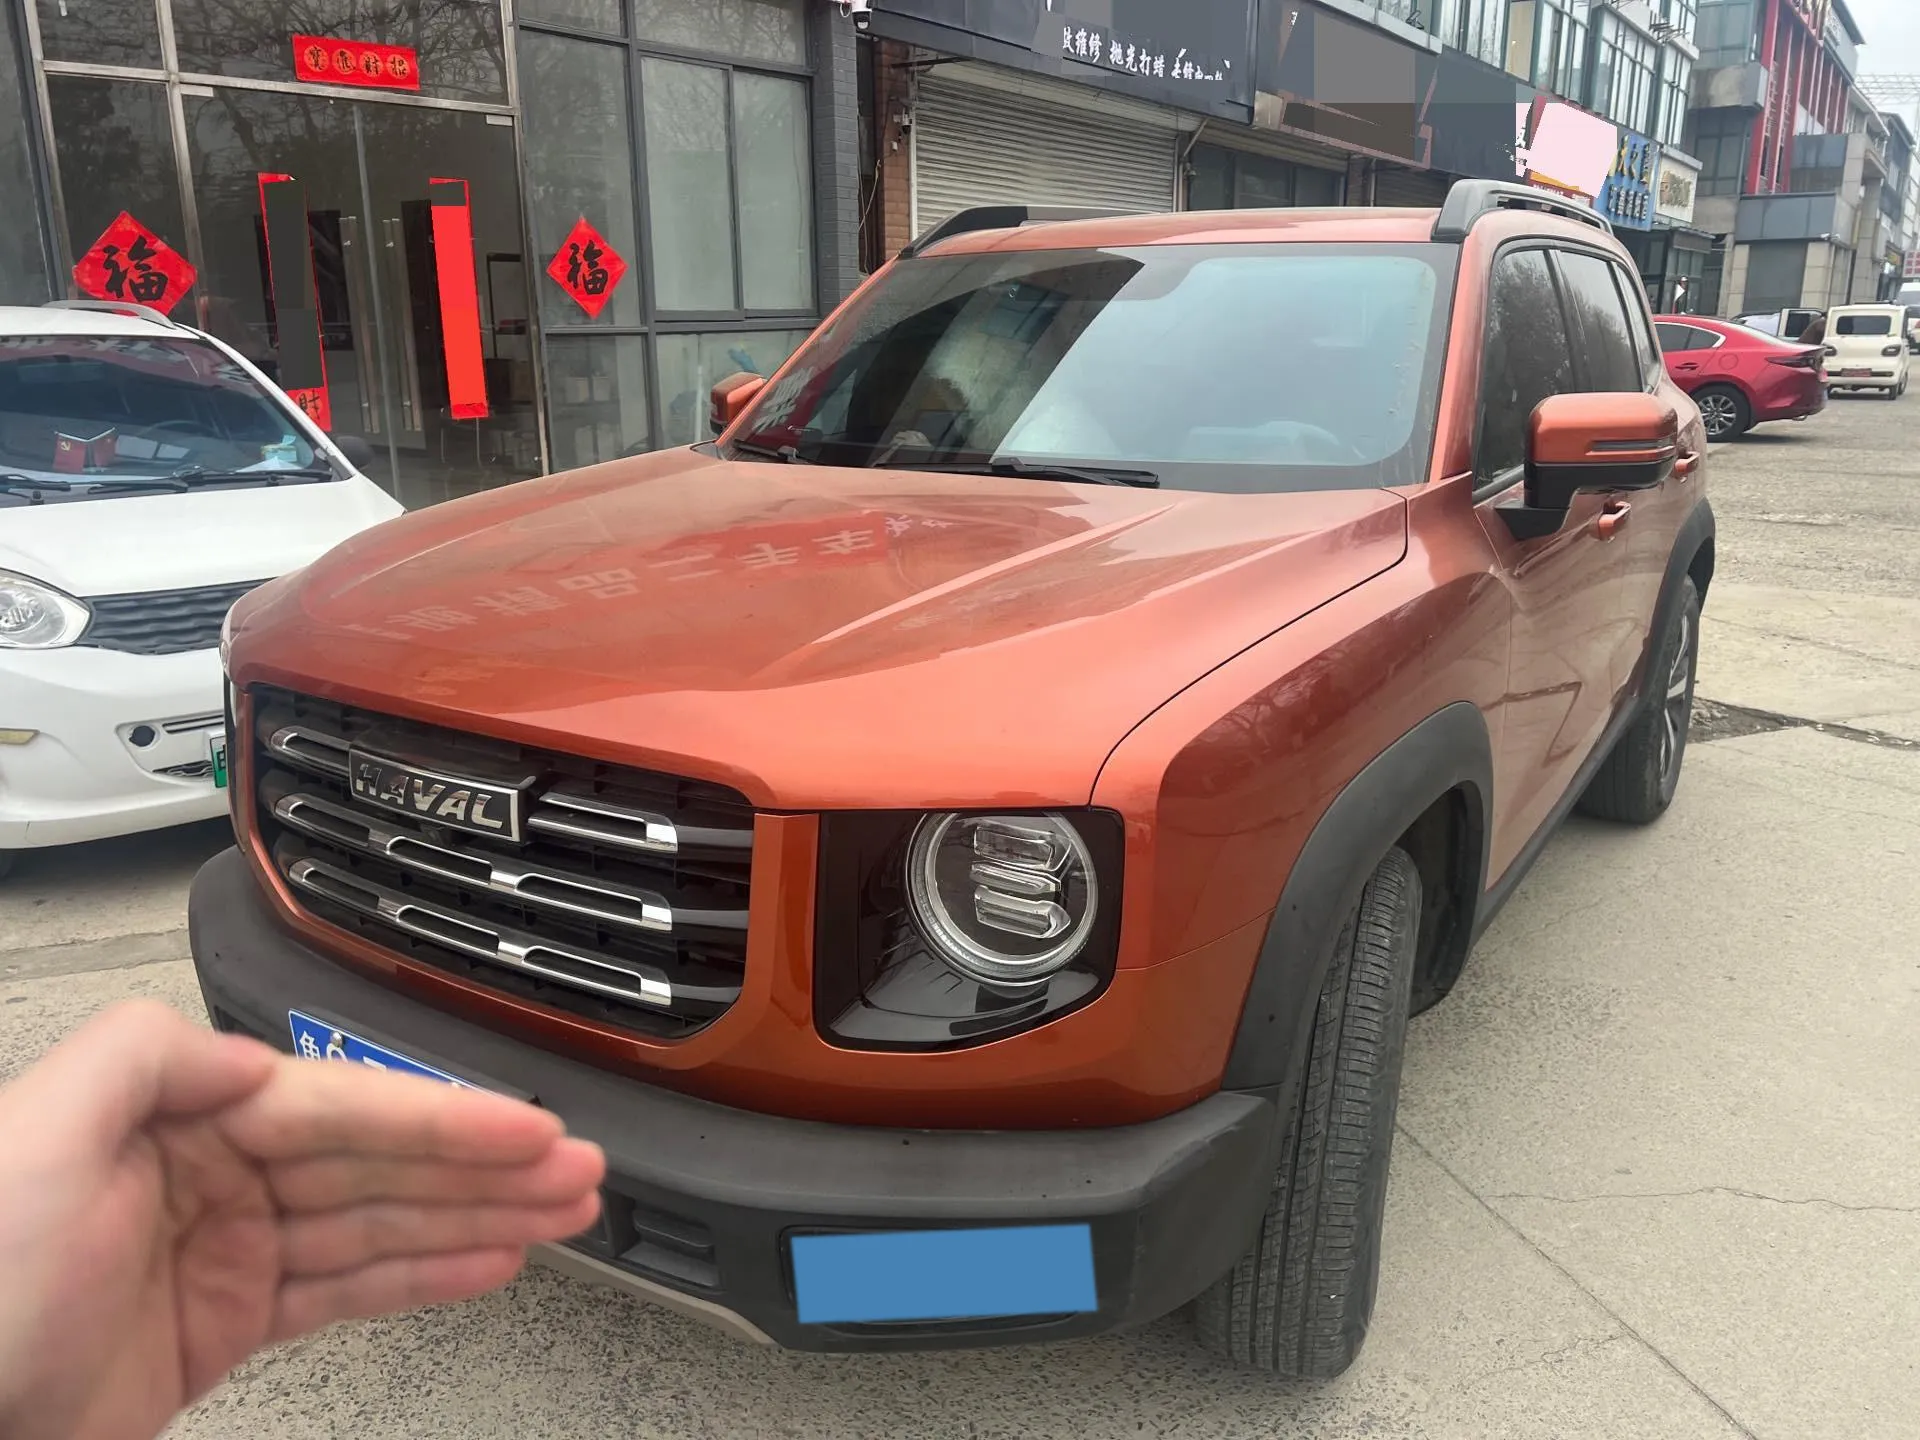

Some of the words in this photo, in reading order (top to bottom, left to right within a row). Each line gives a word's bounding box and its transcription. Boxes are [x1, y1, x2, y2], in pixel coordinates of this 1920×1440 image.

[103, 234, 169, 302] 福
[567, 239, 608, 296] 福
[355, 763, 503, 829] HAVAL
